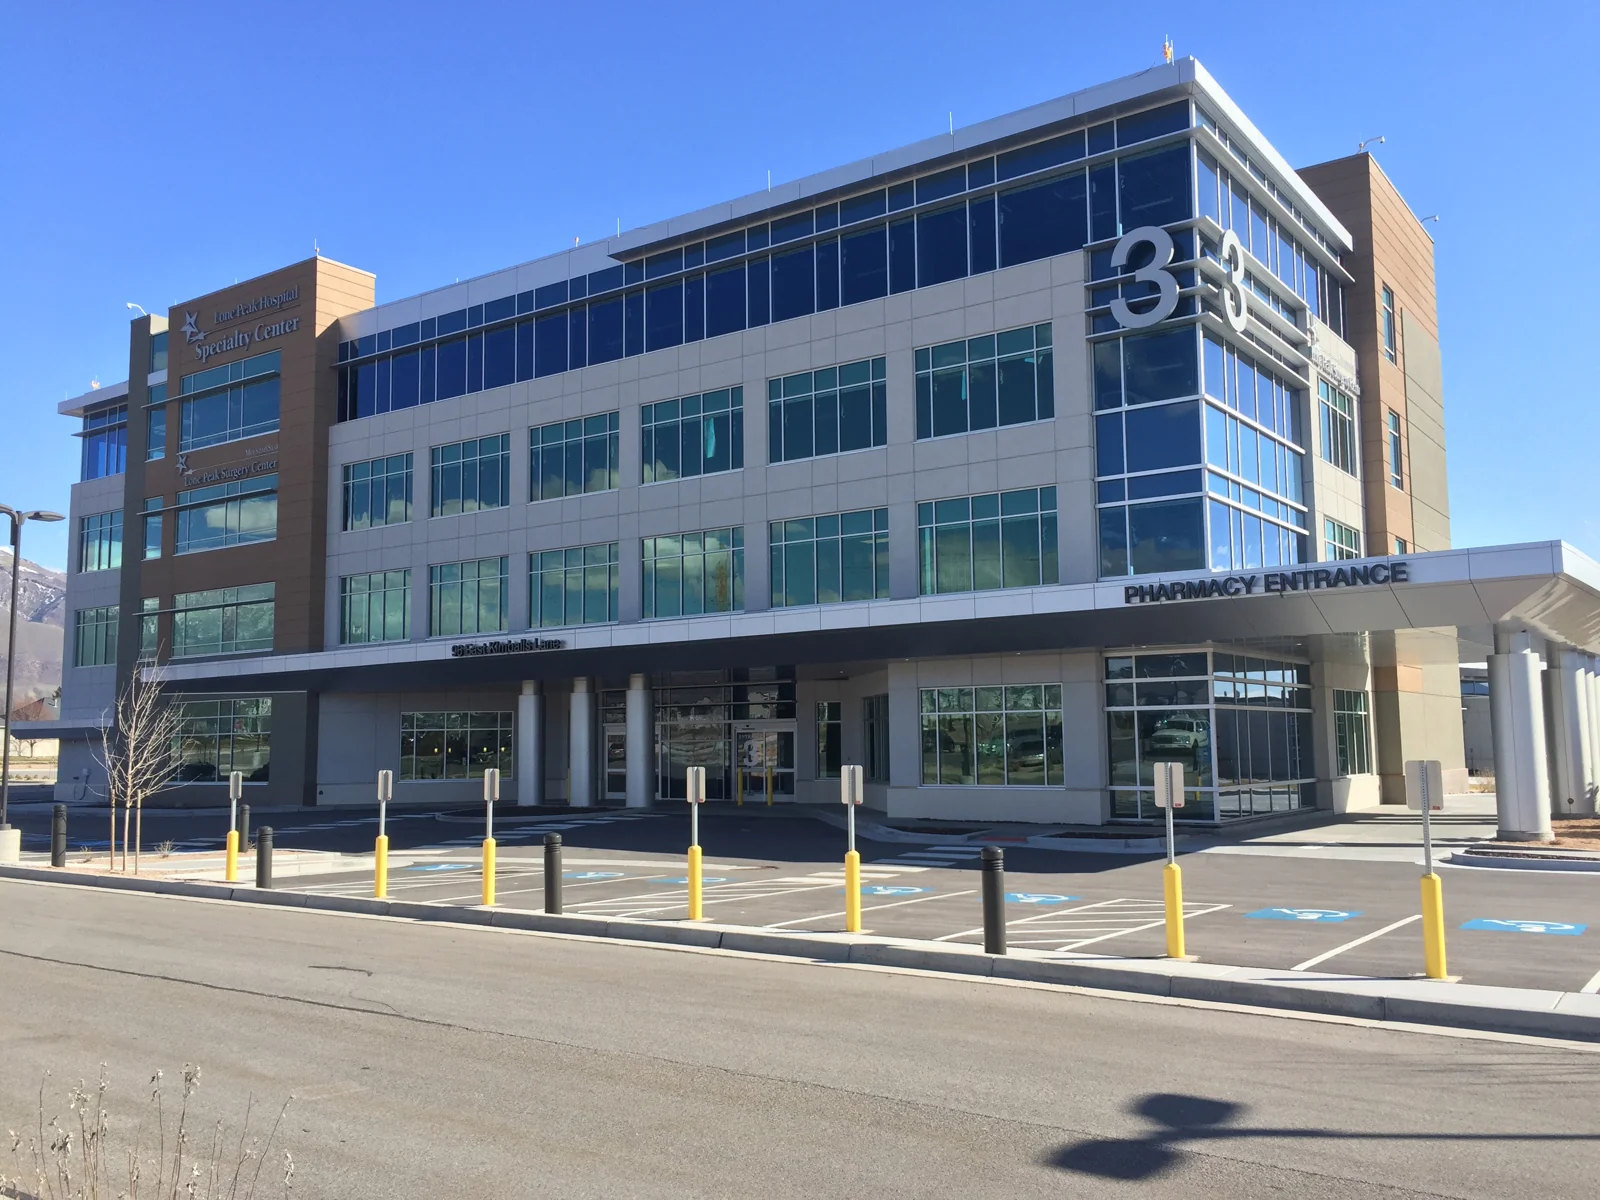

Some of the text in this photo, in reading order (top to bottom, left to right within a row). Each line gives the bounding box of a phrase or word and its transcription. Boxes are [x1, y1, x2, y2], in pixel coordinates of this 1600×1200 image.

[1110, 226, 1180, 329] 3
[1217, 229, 1248, 333] 3
[214, 284, 299, 324] Lone Peak Hospital
[195, 317, 299, 363] Specialty Center
[203, 469, 220, 483] Peak
[221, 465, 249, 480] Surgery
[251, 460, 277, 473] Center
[1124, 562, 1409, 604] PHARMACY ENTRANCE
[464, 643, 488, 655] East
[488, 638, 533, 654] Kimballs
[534, 638, 562, 650] Lane
